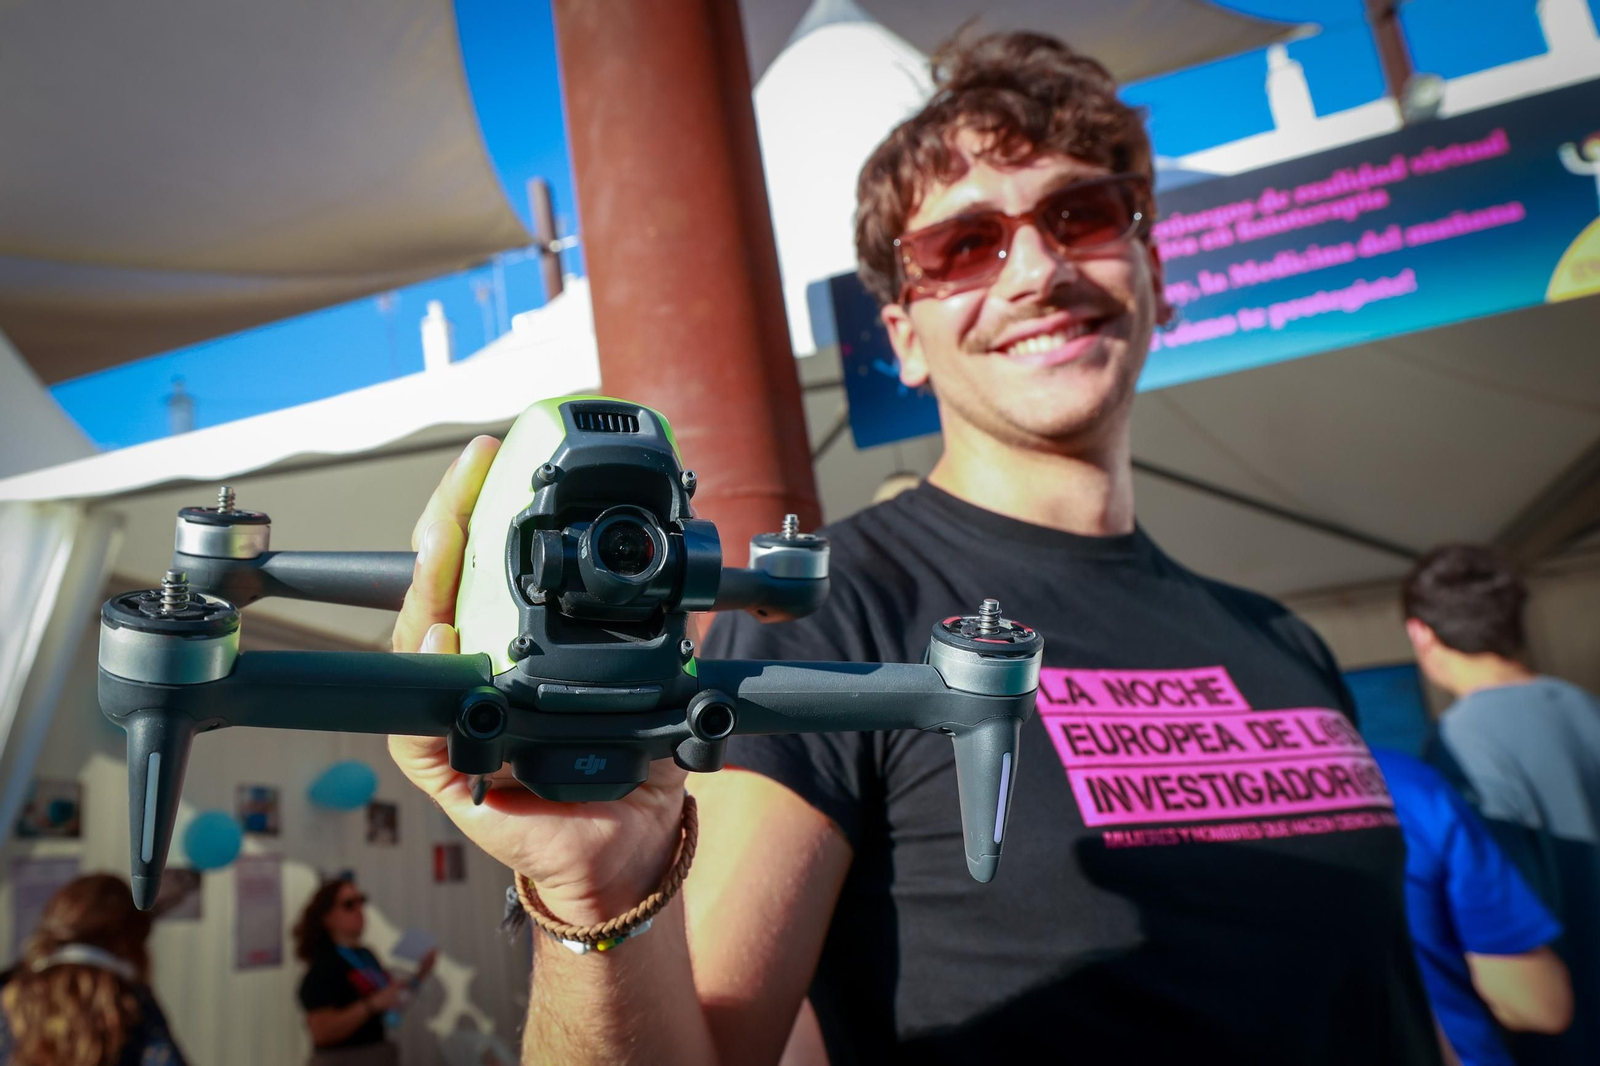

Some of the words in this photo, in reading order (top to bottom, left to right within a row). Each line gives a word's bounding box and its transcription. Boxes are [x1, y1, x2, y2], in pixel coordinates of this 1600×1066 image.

[1039, 676, 1096, 705] LA
[1102, 677, 1234, 708] NOCHE
[1060, 722, 1248, 757] EUROPEA
[1246, 719, 1299, 750] DE
